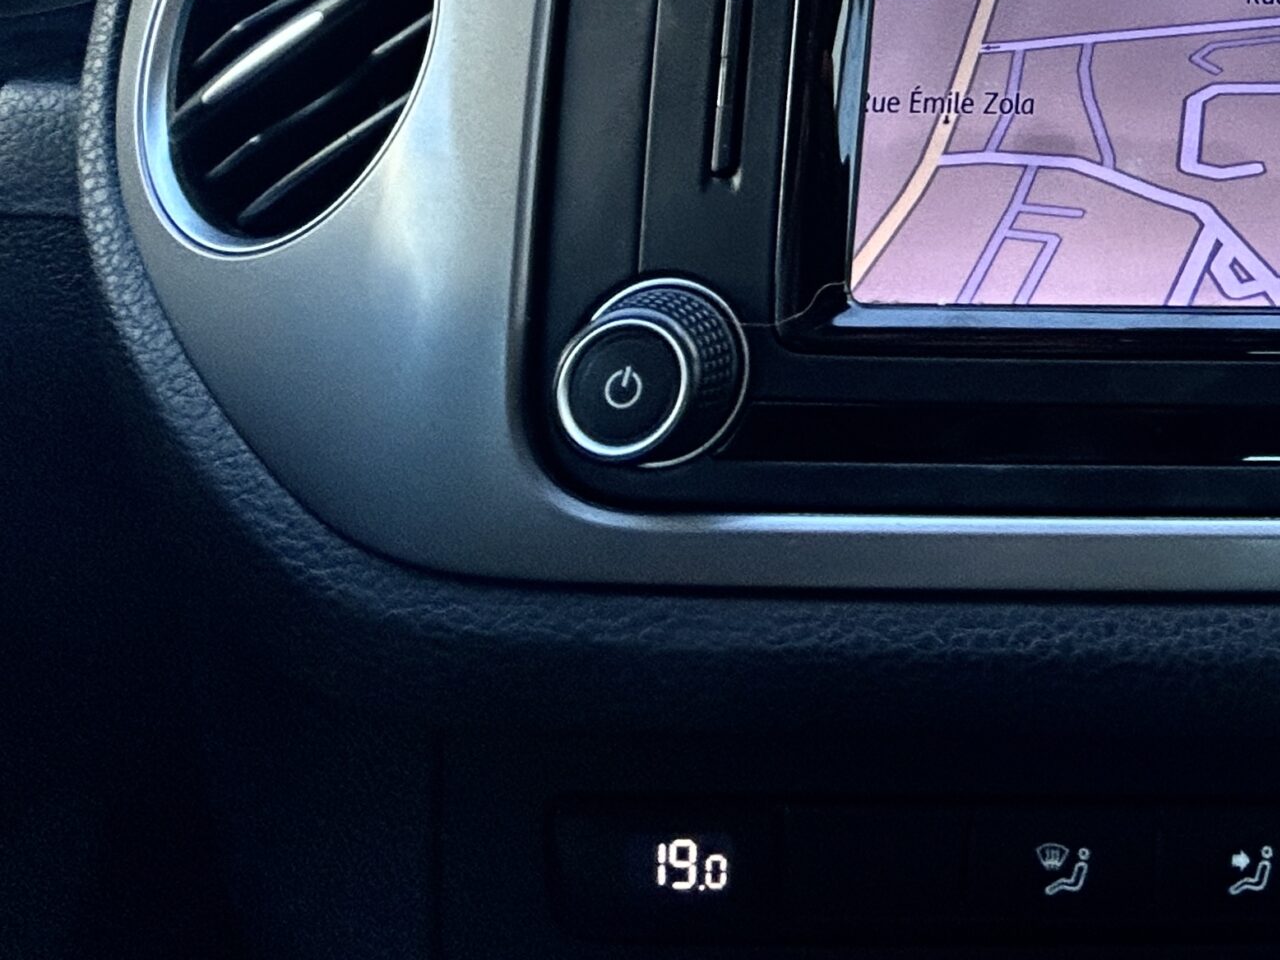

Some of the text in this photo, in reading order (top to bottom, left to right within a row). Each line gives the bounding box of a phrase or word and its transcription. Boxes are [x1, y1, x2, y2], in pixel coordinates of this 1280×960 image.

[909, 85, 974, 114] Émile
[983, 92, 1034, 115] Zola
[657, 838, 728, 891] 19.0
